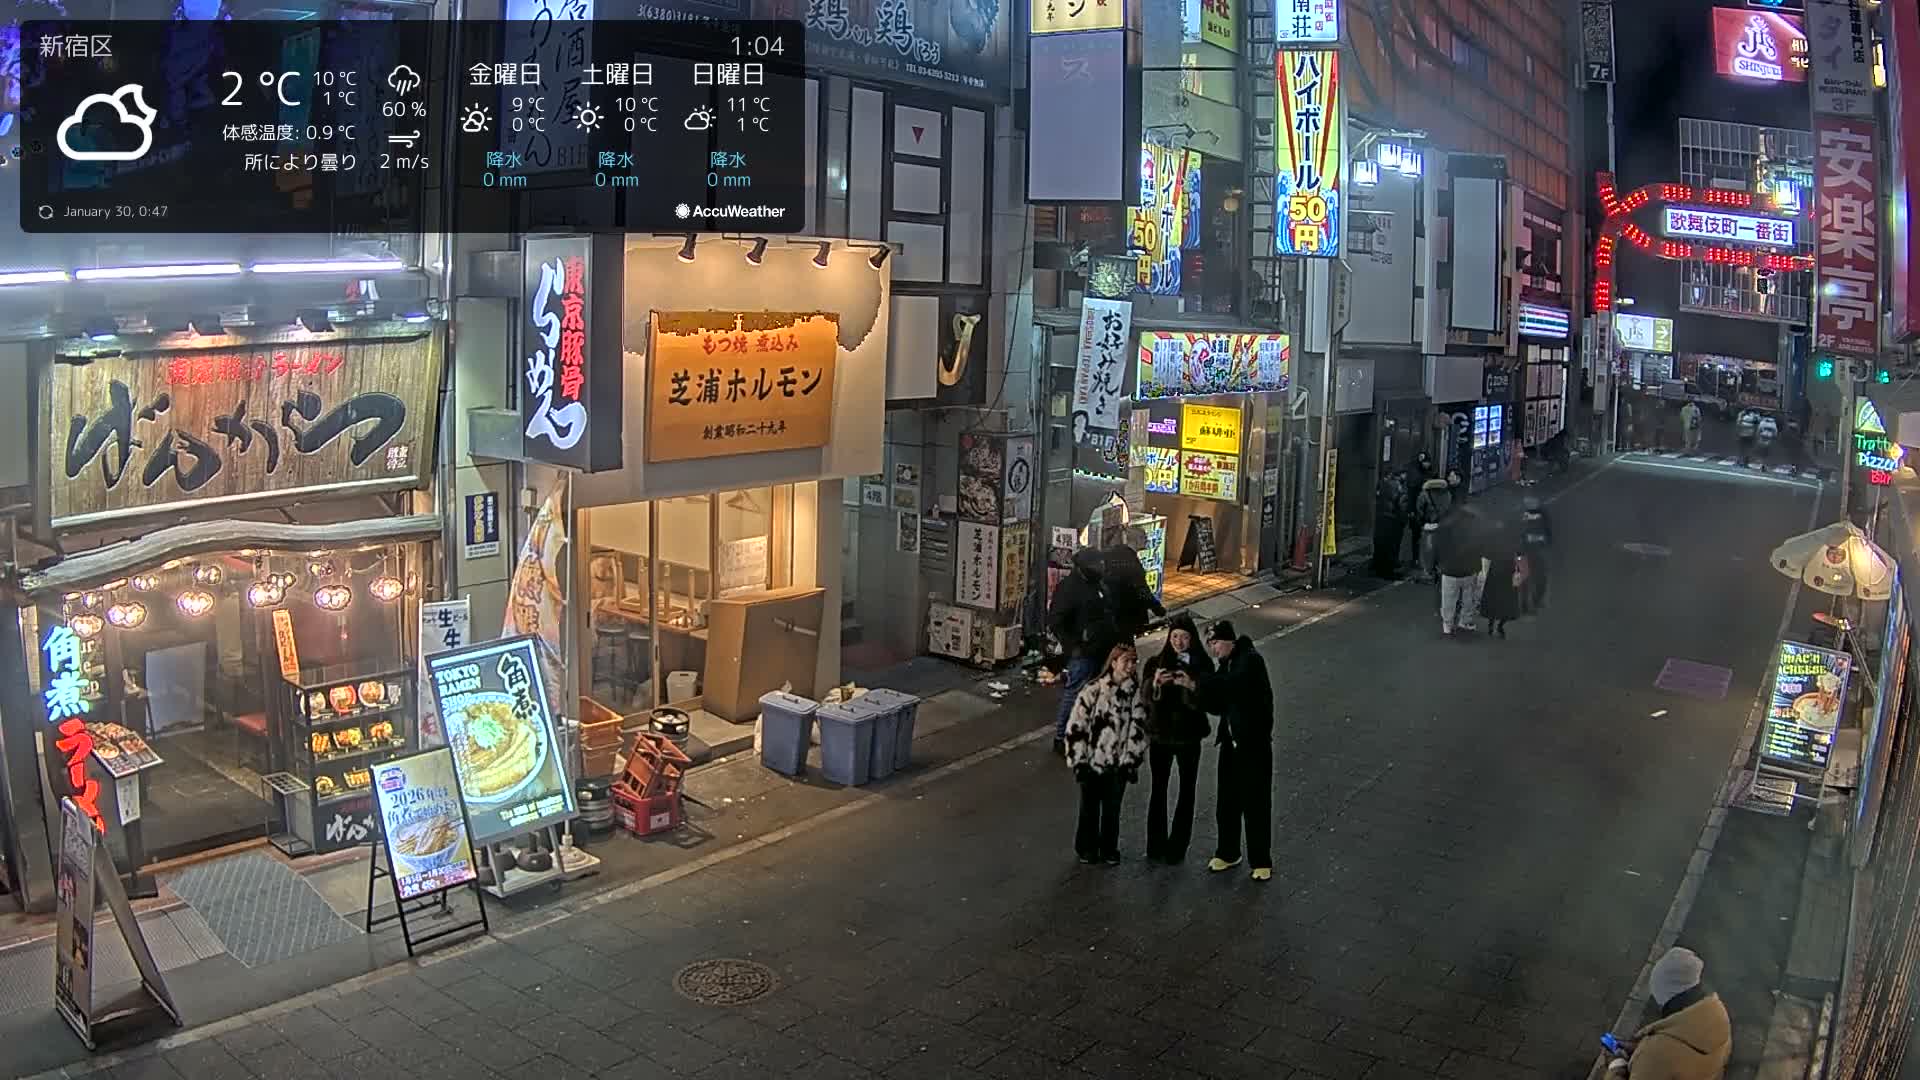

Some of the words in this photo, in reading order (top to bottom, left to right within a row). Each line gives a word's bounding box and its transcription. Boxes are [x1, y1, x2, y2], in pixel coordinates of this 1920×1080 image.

[1590, 64, 1609, 79] 7F
[1294, 53, 1321, 191] ハイボール
[1670, 211, 1789, 242] 歌舞伎町一番街
[1820, 127, 1875, 330] 安楽亭
[560, 255, 585, 401] 東京豚骨
[668, 365, 824, 407] 芝浦ホルモン
[435, 664, 480, 684] TOKYO
[439, 677, 482, 698] RAMEN
[498, 653, 538, 721] 角煮
